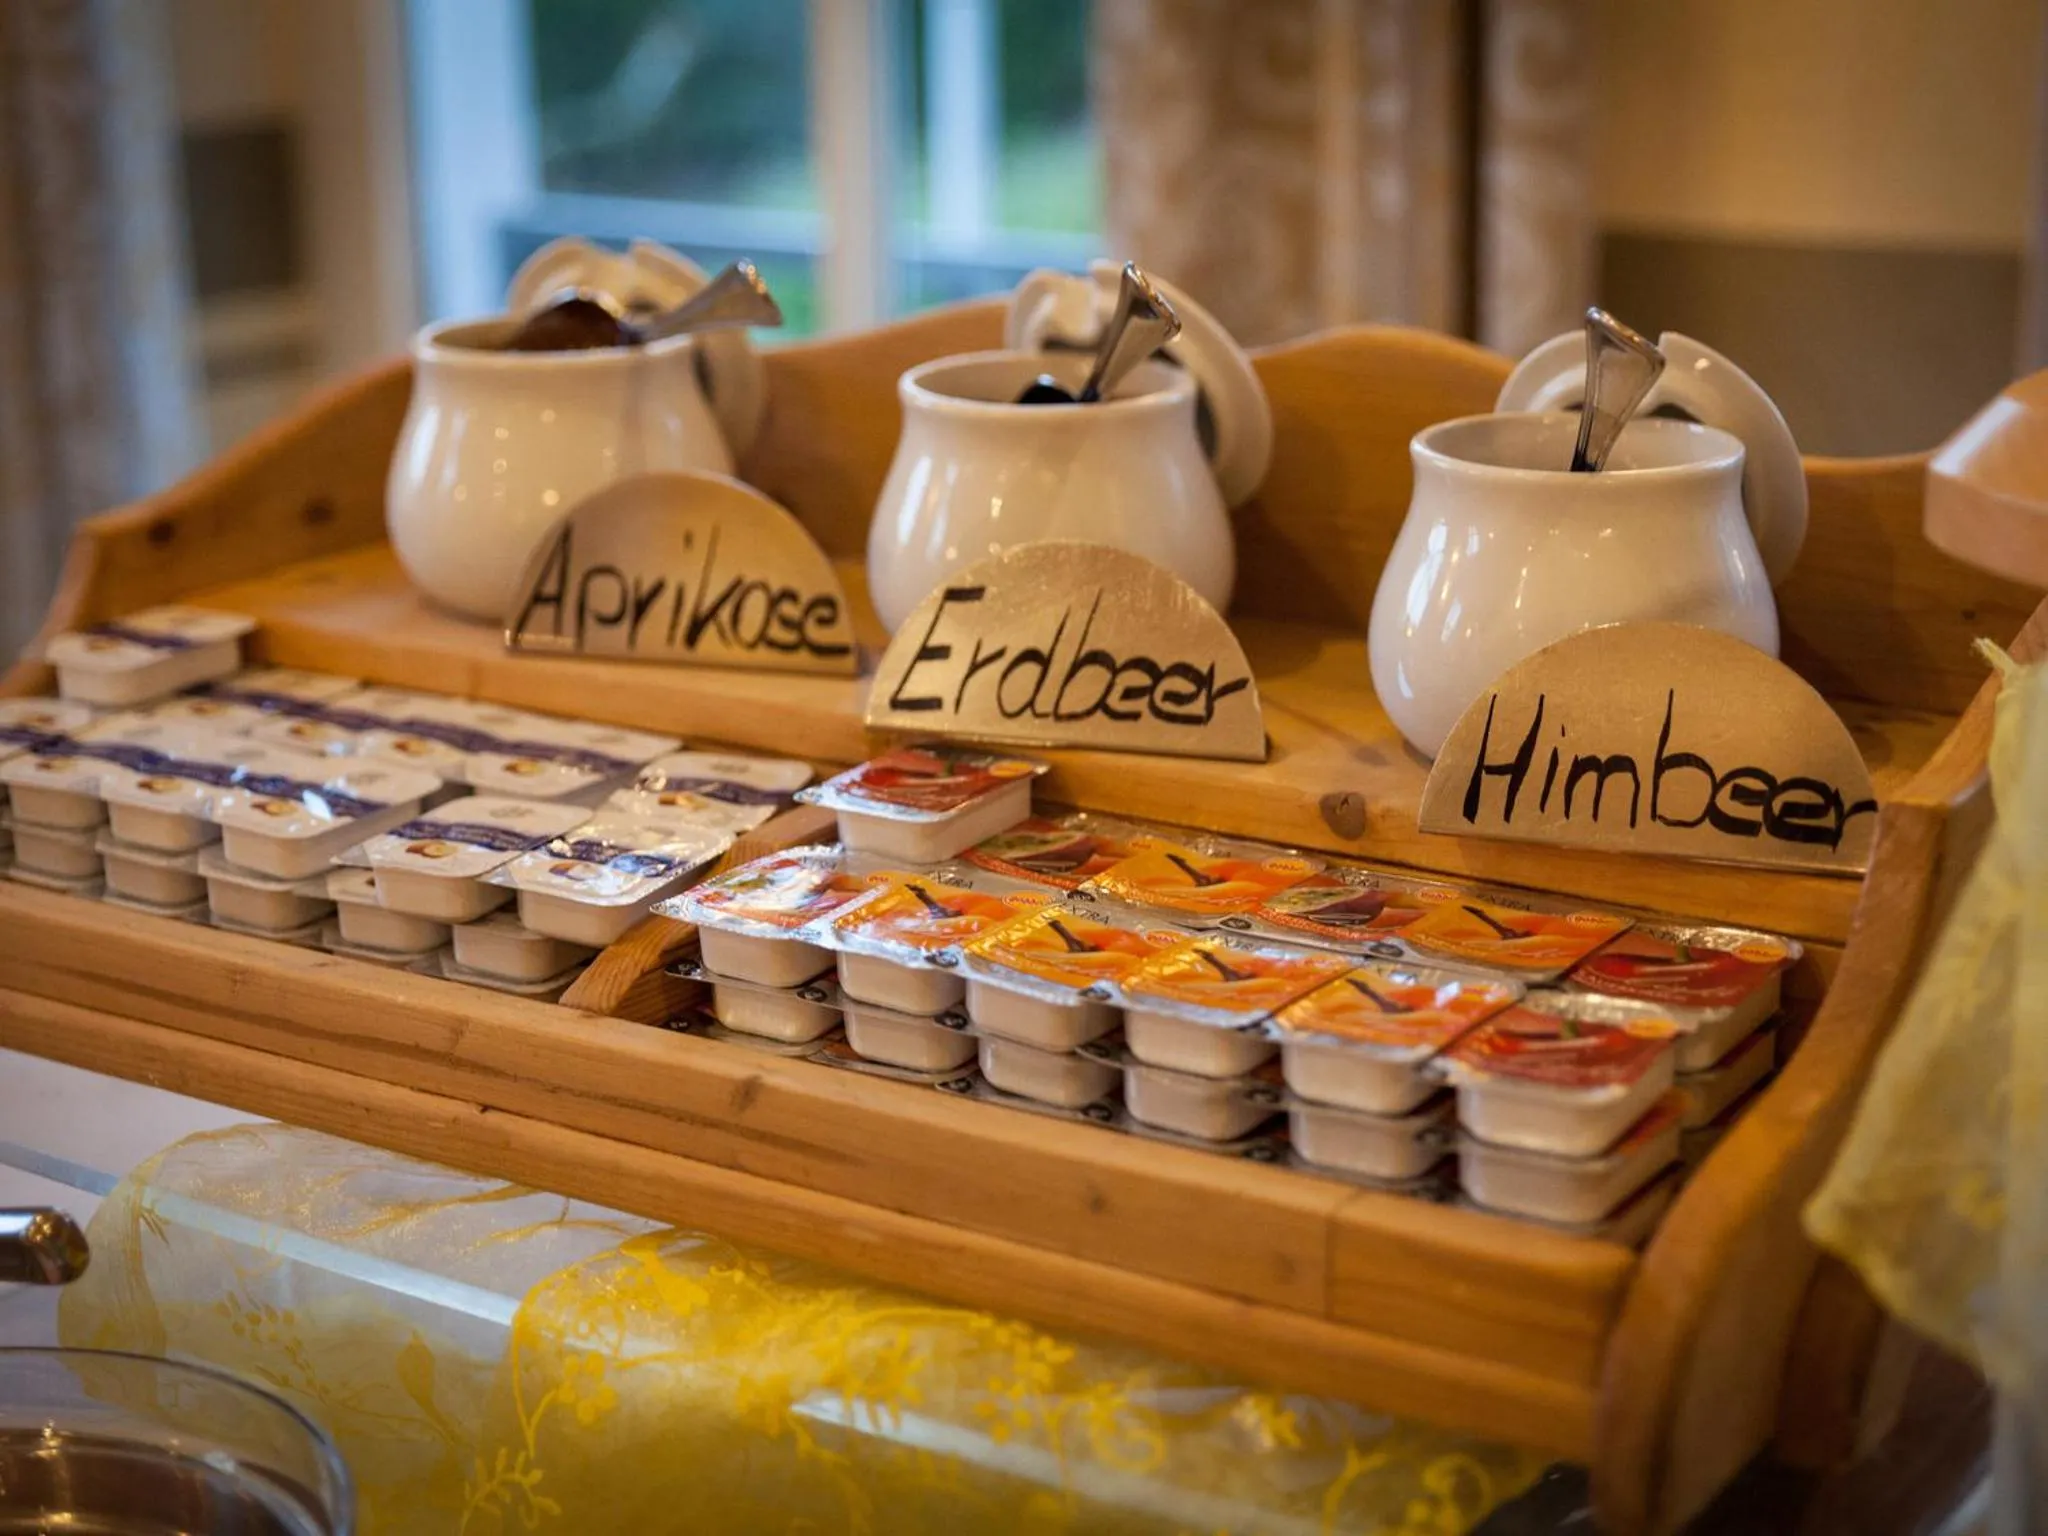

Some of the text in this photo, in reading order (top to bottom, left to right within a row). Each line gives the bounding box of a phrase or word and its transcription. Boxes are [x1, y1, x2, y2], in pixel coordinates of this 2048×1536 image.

[514, 519, 851, 656] Aprikose
[889, 586, 1250, 727] Erdbeer
[1462, 688, 1878, 853] Himbeer
